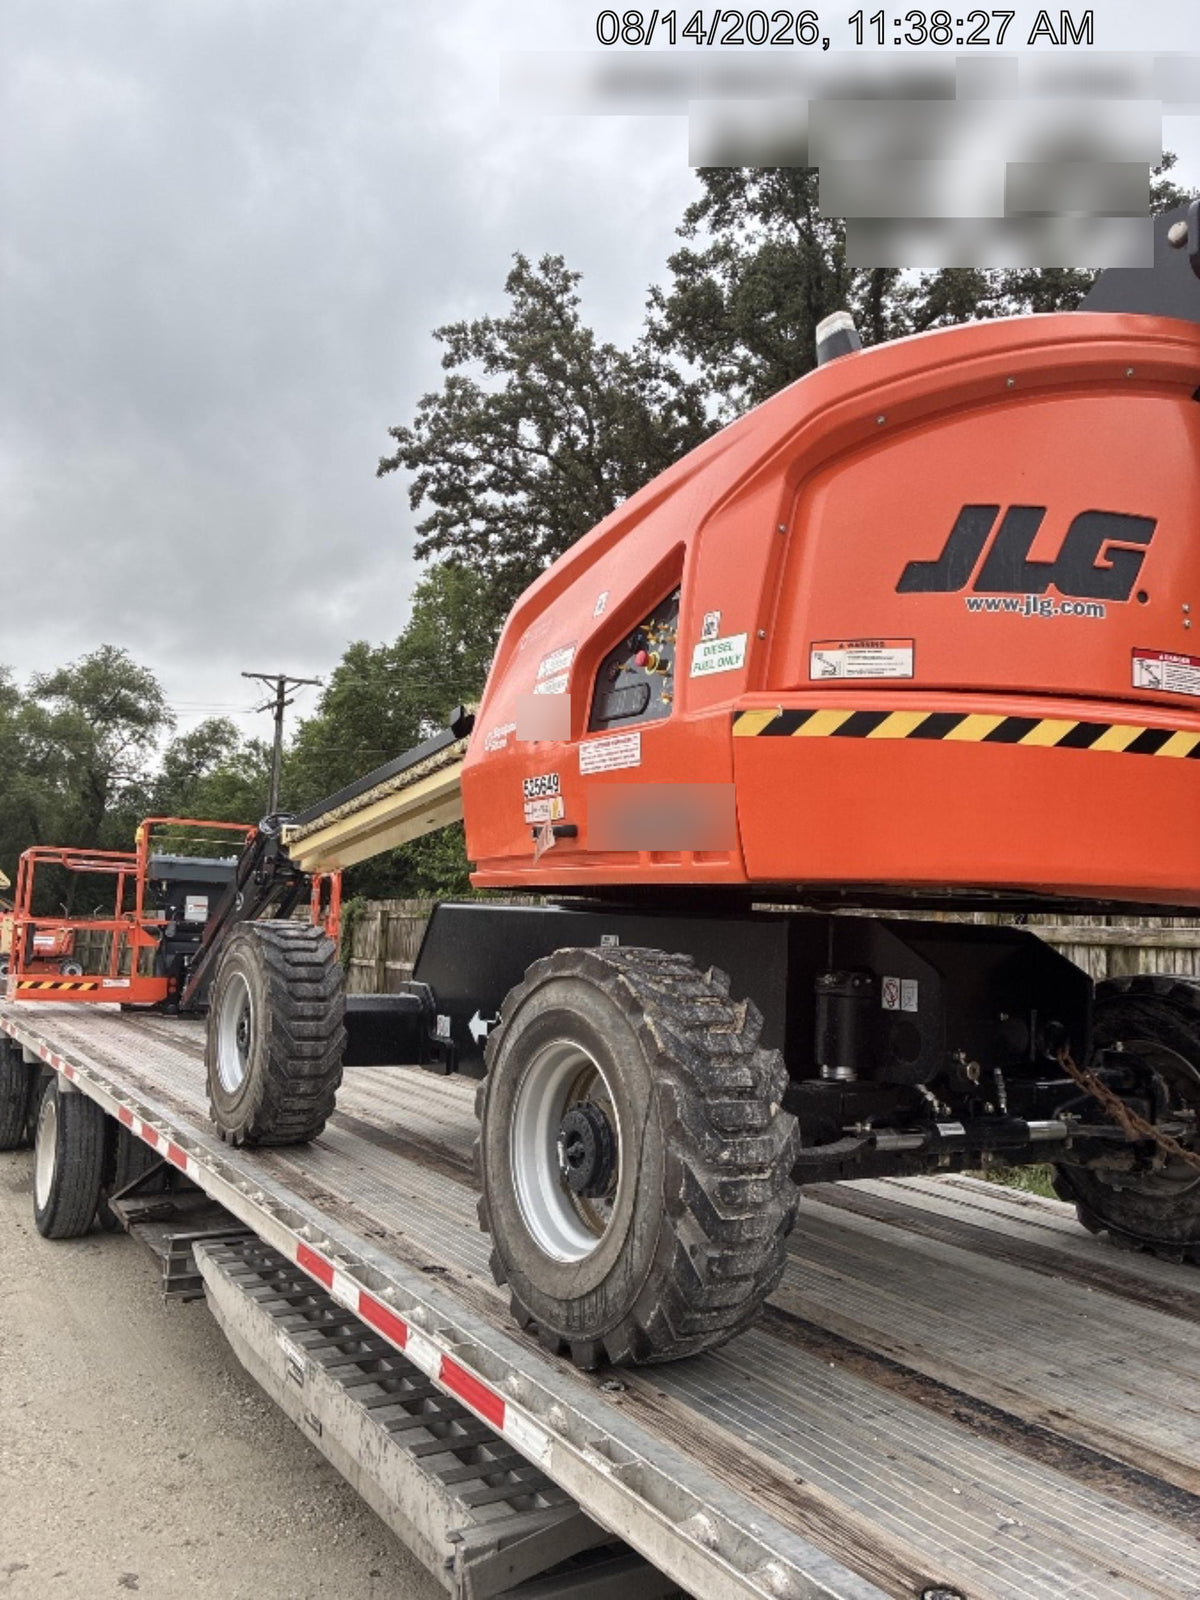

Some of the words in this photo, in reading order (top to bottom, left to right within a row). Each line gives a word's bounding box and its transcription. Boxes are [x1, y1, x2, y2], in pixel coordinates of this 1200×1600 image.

[966, 594, 1106, 618] www.jlg.com
[703, 641, 733, 657] DIESEL
[693, 659, 715, 673] FUEL
[717, 654, 742, 668] ONLY
